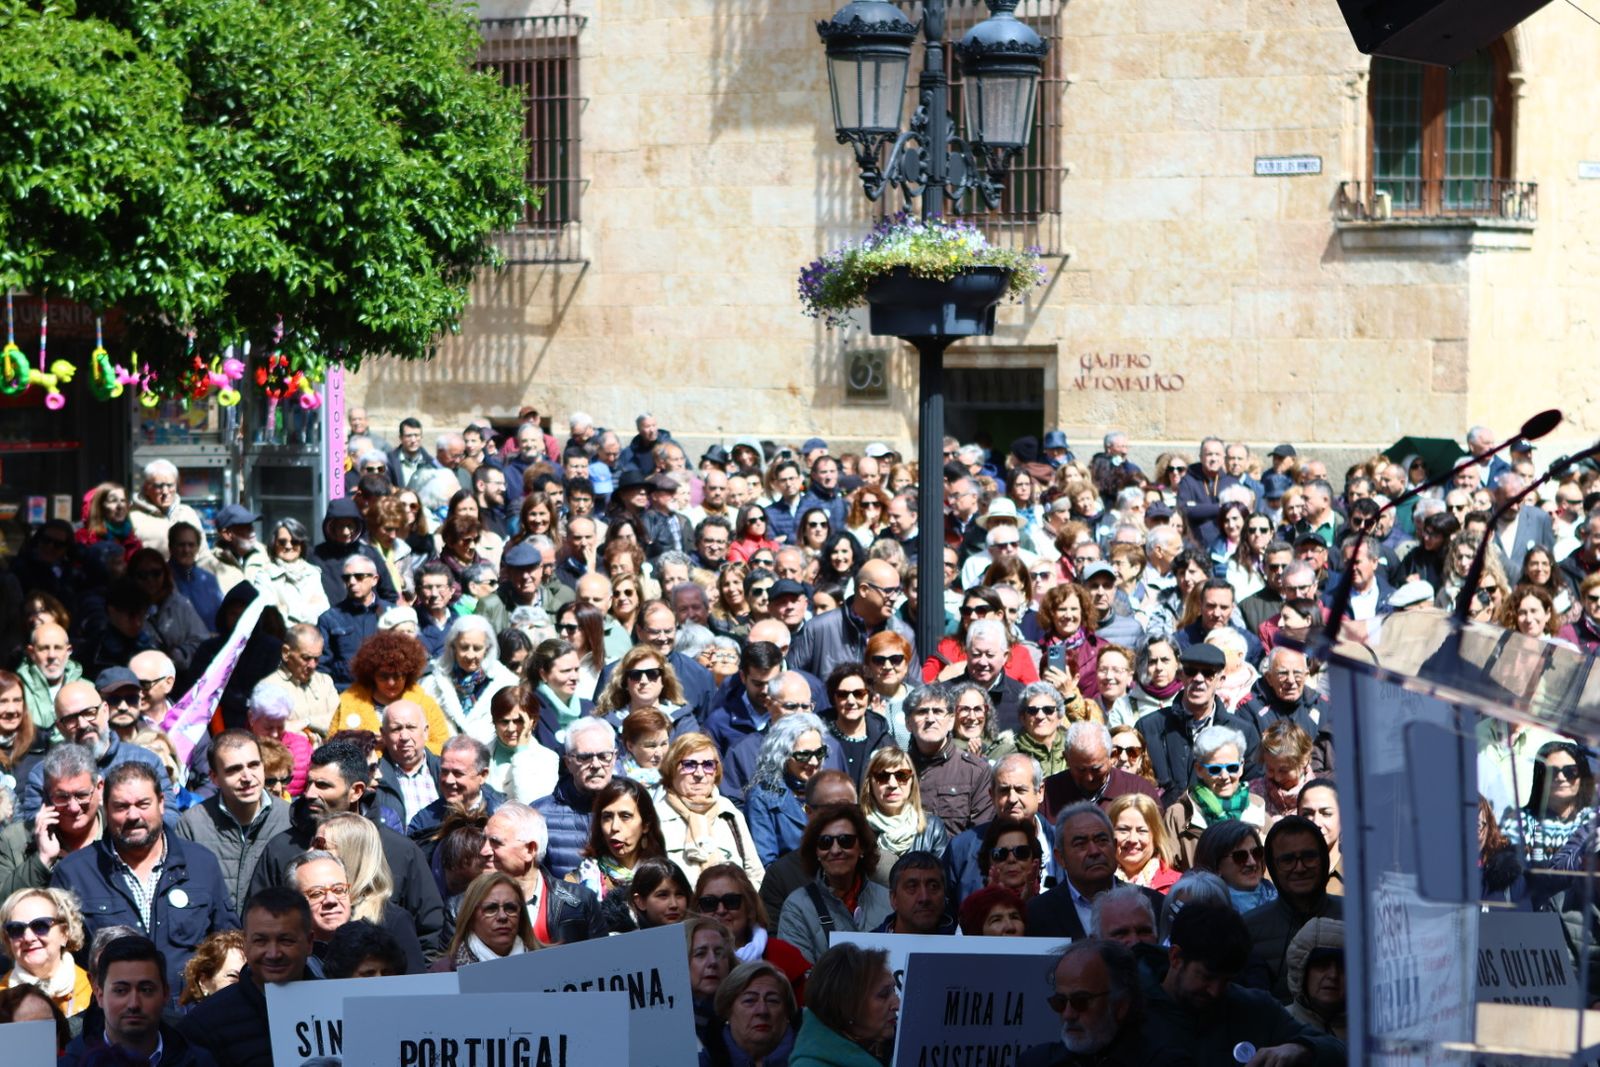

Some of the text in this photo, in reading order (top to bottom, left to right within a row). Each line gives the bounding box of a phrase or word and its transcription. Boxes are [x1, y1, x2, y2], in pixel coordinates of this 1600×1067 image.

[1500, 948, 1567, 988] QUITAN
[943, 990, 1024, 1026] MIRA LA
[295, 1019, 343, 1058] SIN
